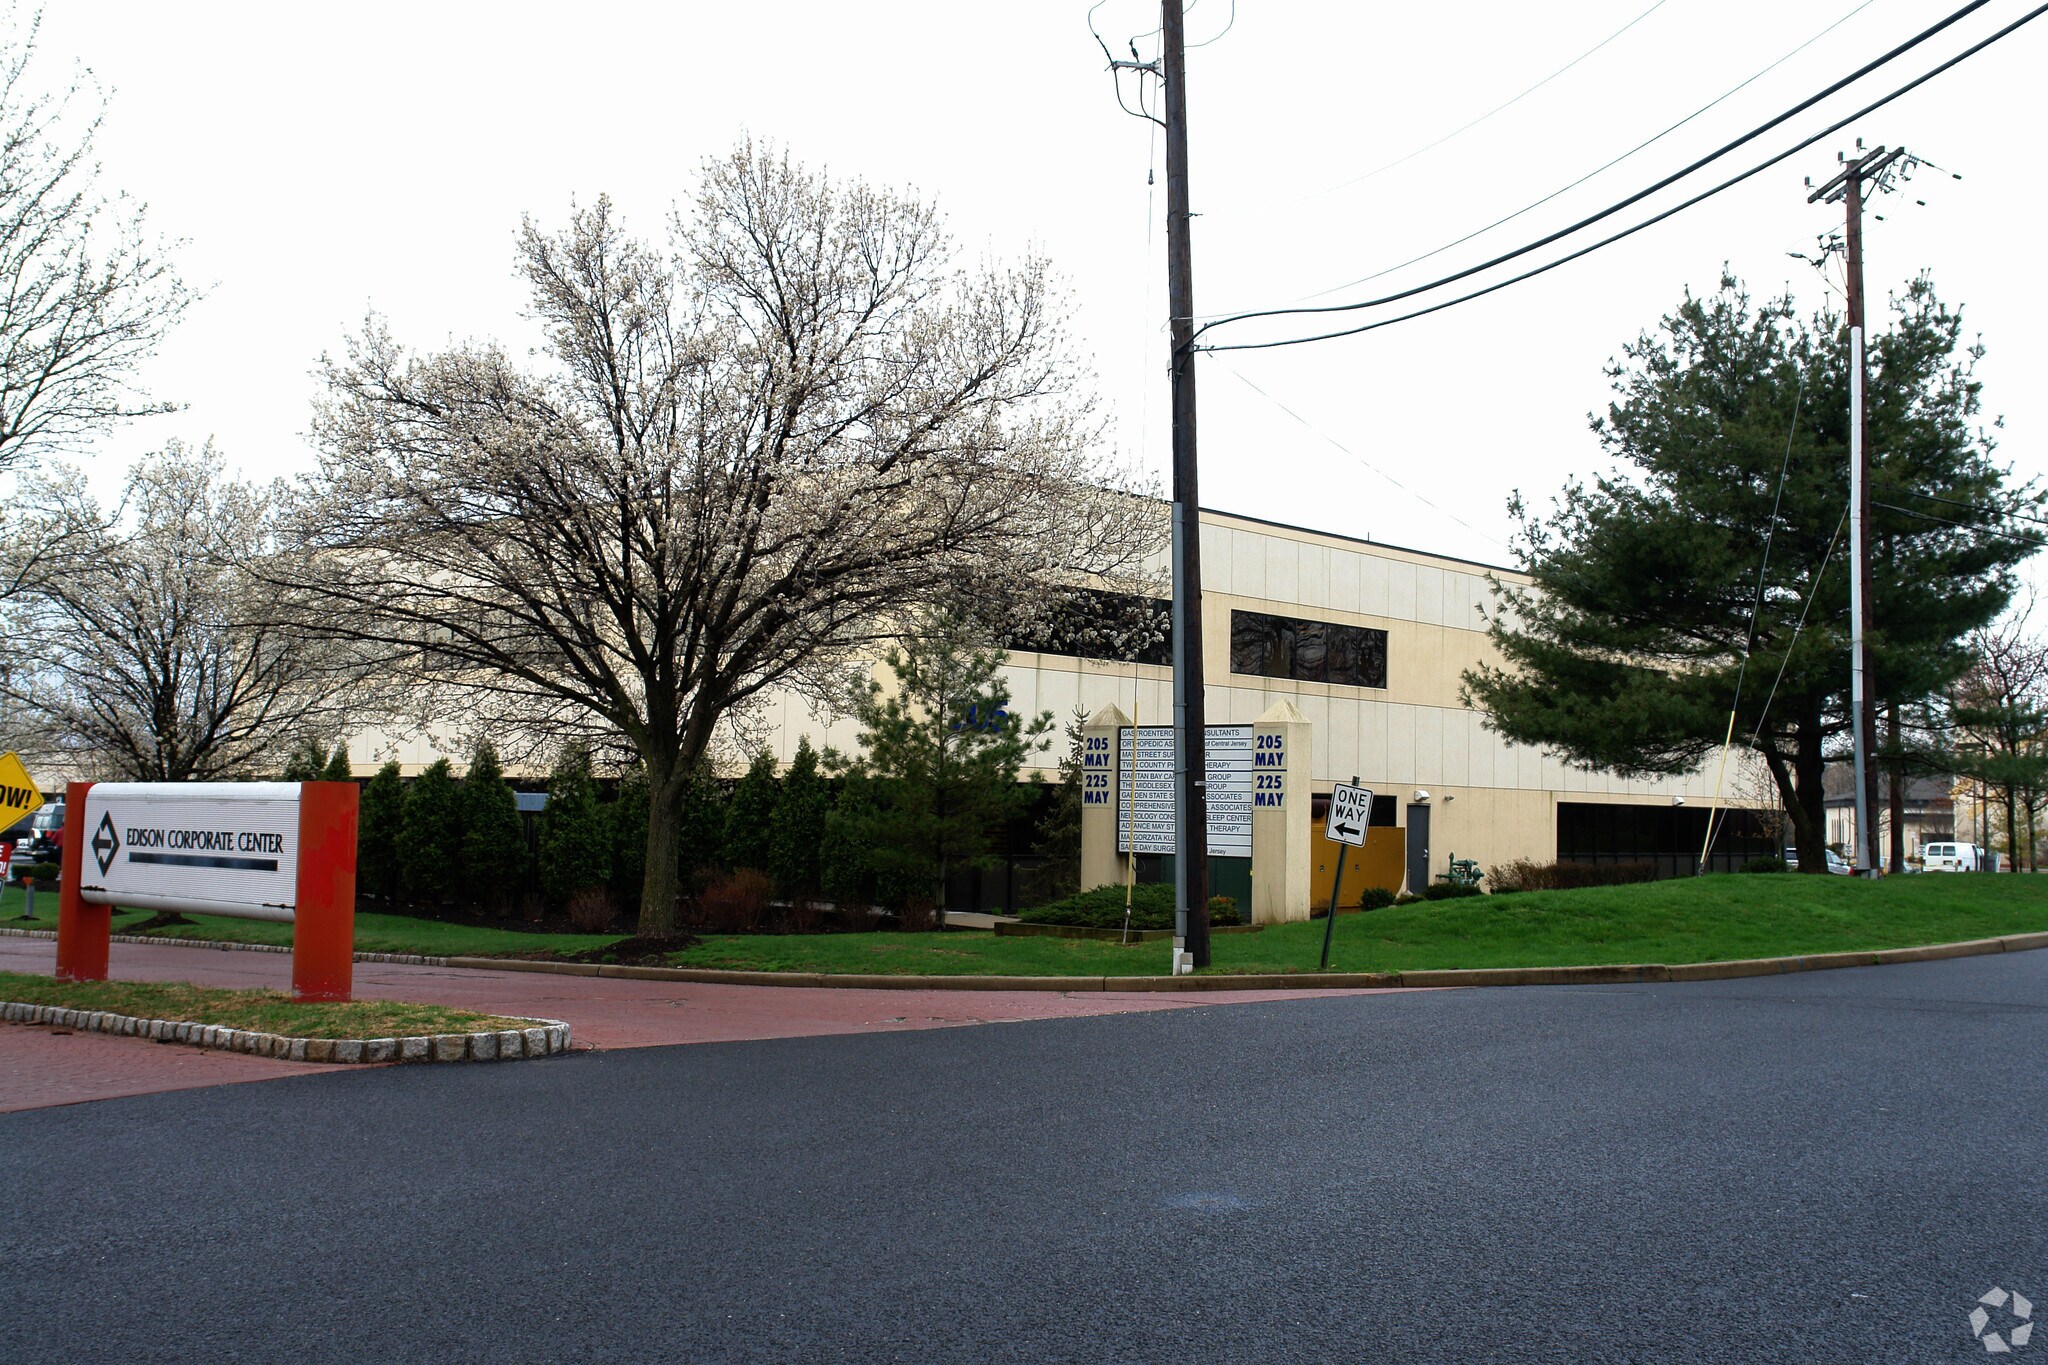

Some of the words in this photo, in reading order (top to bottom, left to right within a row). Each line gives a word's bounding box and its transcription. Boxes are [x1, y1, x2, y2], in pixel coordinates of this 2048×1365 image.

[1087, 737, 1108, 750] 205
[1230, 740, 1248, 748] Jersey
[1257, 735, 1282, 749] 205
[1084, 753, 1110, 767] MAY
[1255, 752, 1284, 766] MAY
[1086, 775, 1107, 787] 225
[1257, 775, 1282, 789] 225
[1084, 791, 1109, 804] MAY
[1255, 792, 1284, 806] MAY
[1338, 789, 1367, 808] ONE
[1121, 801, 1175, 809] COPREHENSIVE
[1335, 804, 1365, 822] WAY
[126, 828, 165, 848] EDISON
[168, 829, 234, 851] CORPORATE
[238, 832, 284, 853] CENTER
[1209, 847, 1226, 855] Jersey
